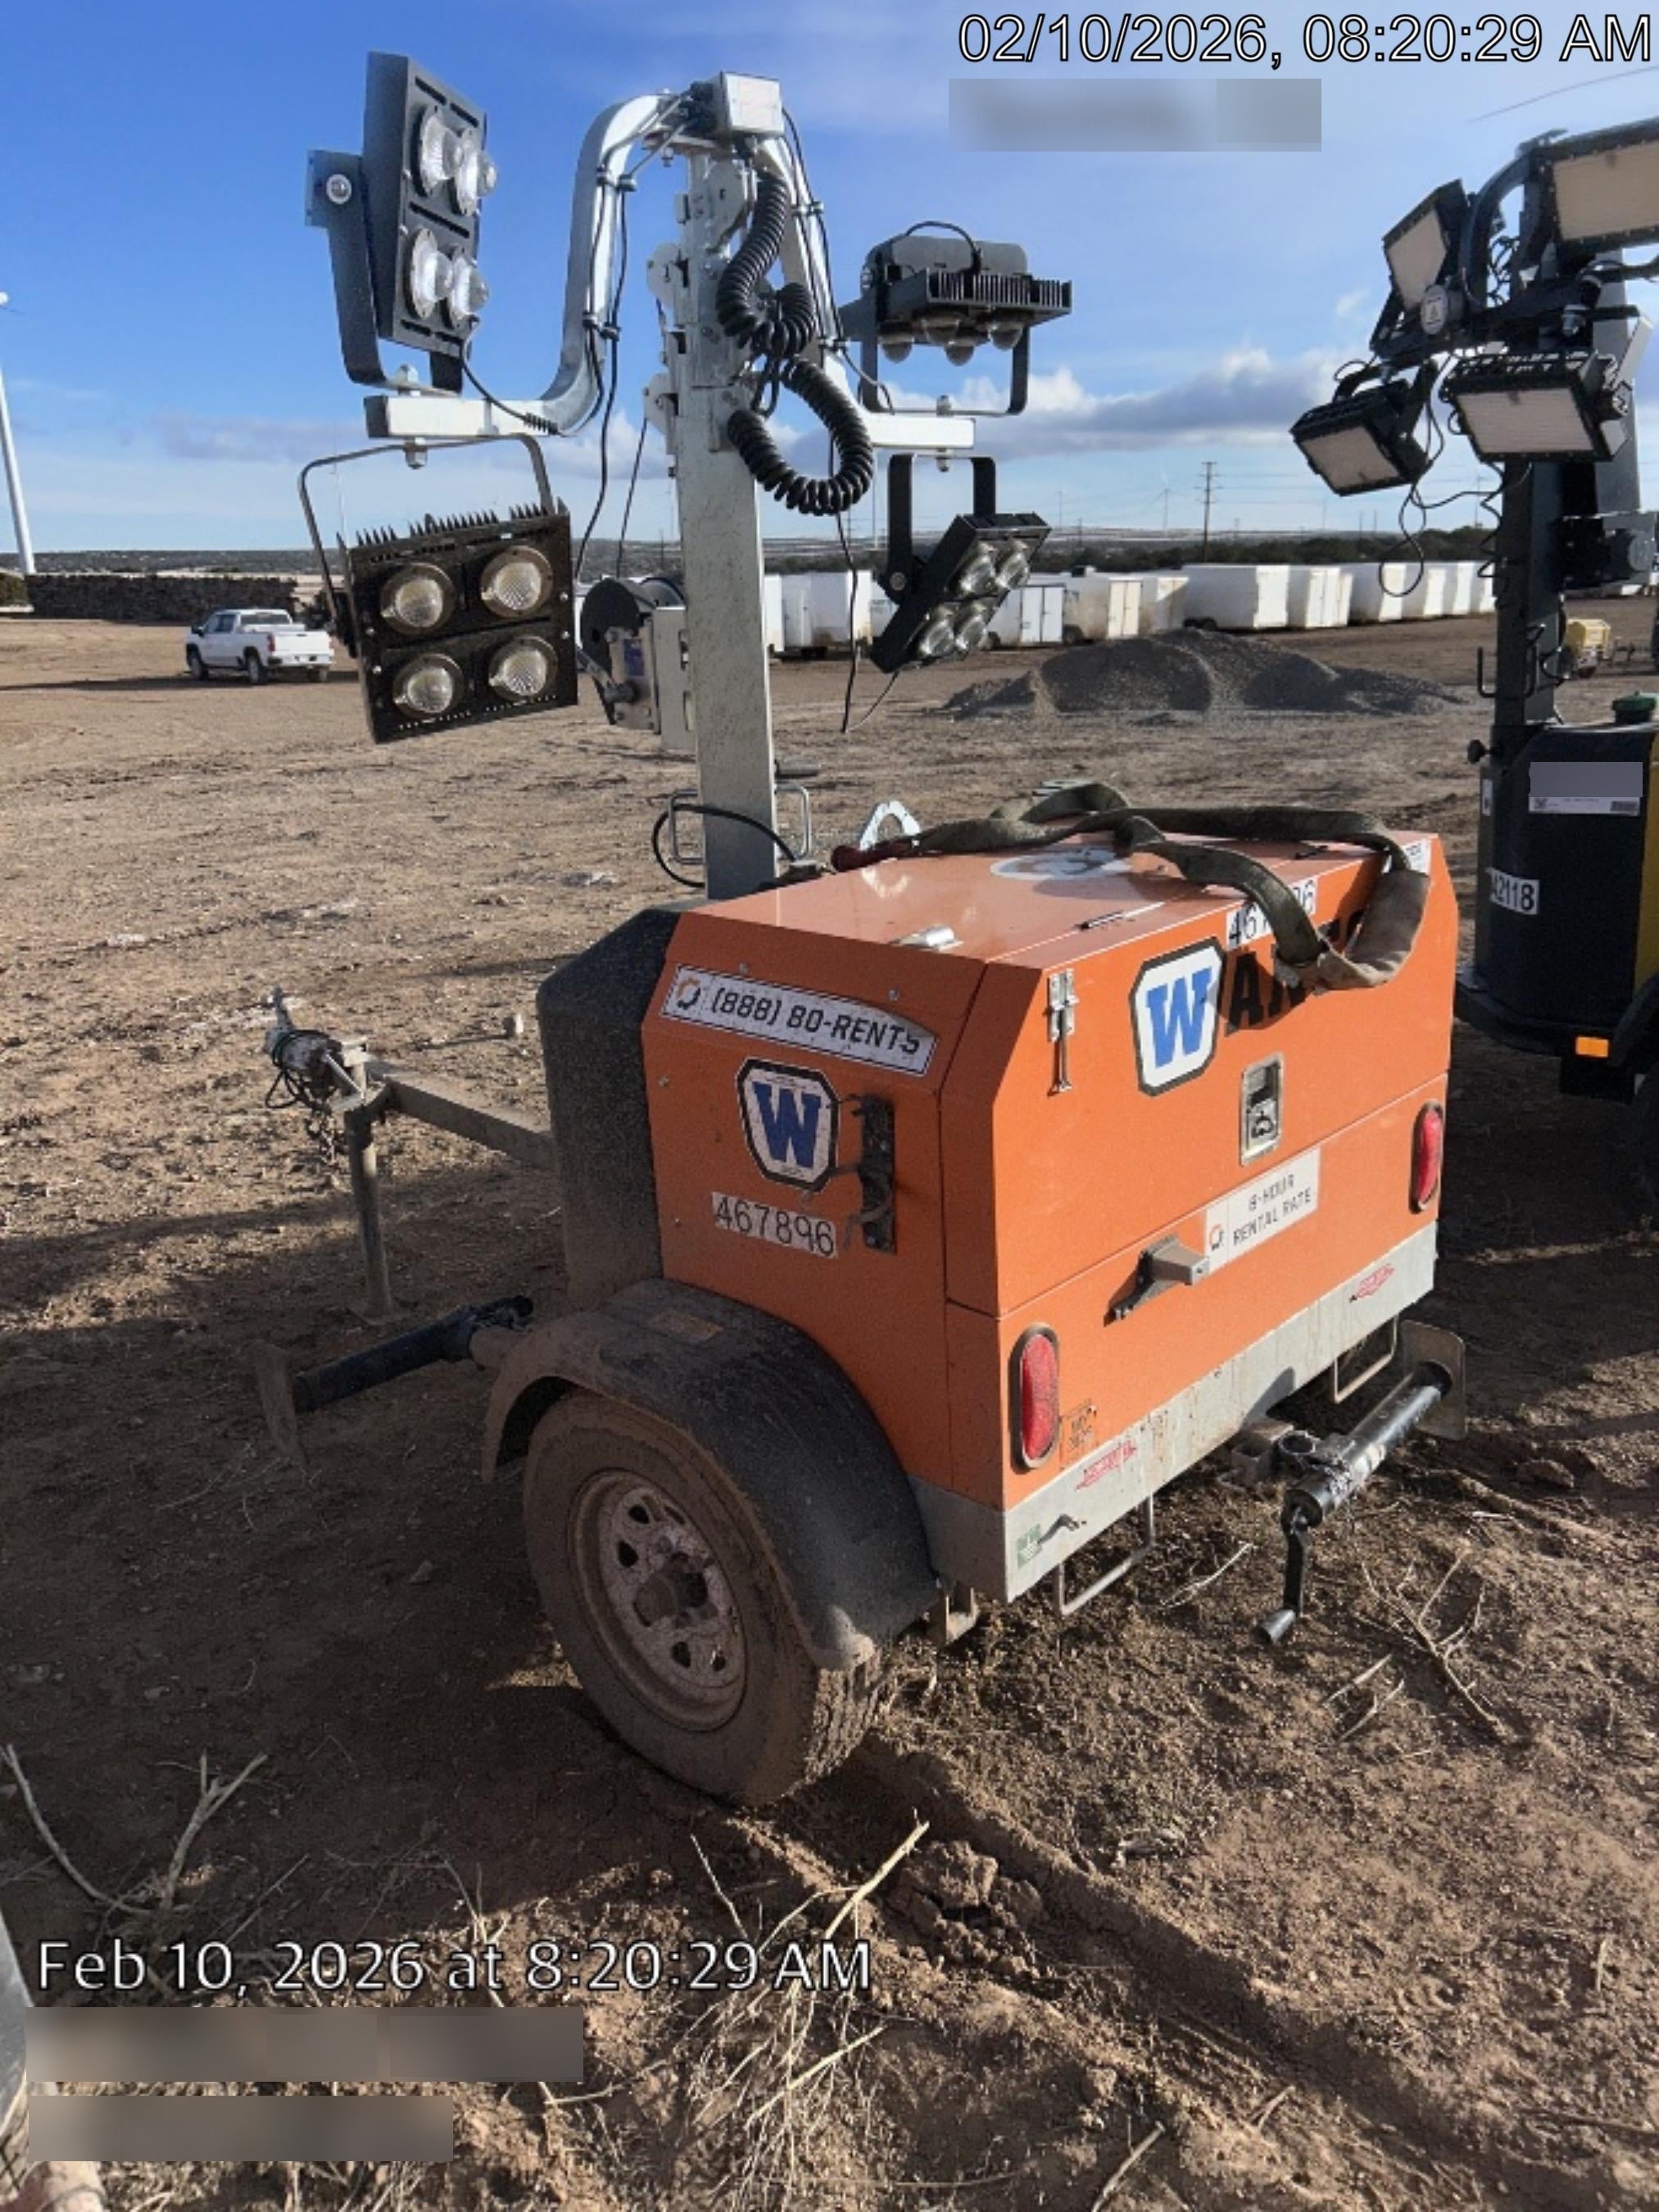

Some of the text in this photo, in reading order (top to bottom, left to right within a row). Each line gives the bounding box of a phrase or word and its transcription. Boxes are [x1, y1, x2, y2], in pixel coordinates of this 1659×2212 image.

[711, 987, 920, 1055] (888) 80-RENTS
[1146, 966, 1213, 1069] W
[752, 1081, 821, 1168] W
[714, 1196, 834, 1256] 467896
[1233, 1186, 1312, 1246] RENTAL RATE
